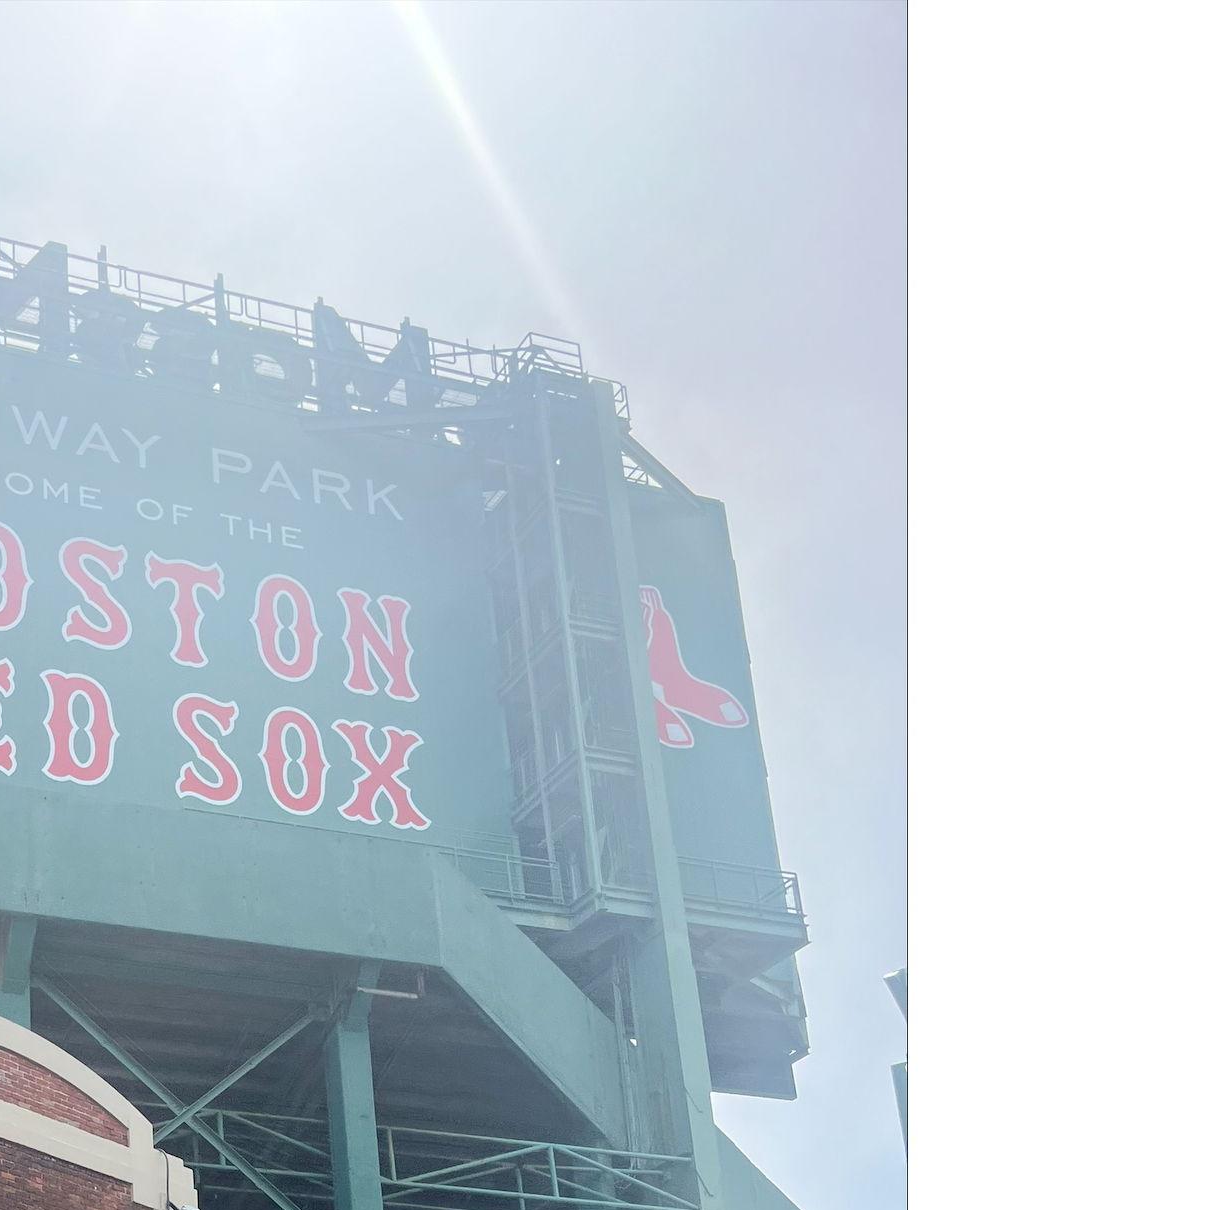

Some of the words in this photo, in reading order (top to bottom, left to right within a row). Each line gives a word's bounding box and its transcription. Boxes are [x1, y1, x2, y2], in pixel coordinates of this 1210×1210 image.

[212, 448, 405, 521] PARK
[136, 498, 193, 526] OF
[221, 513, 304, 550] THE
[172, 692, 431, 831] SOX
